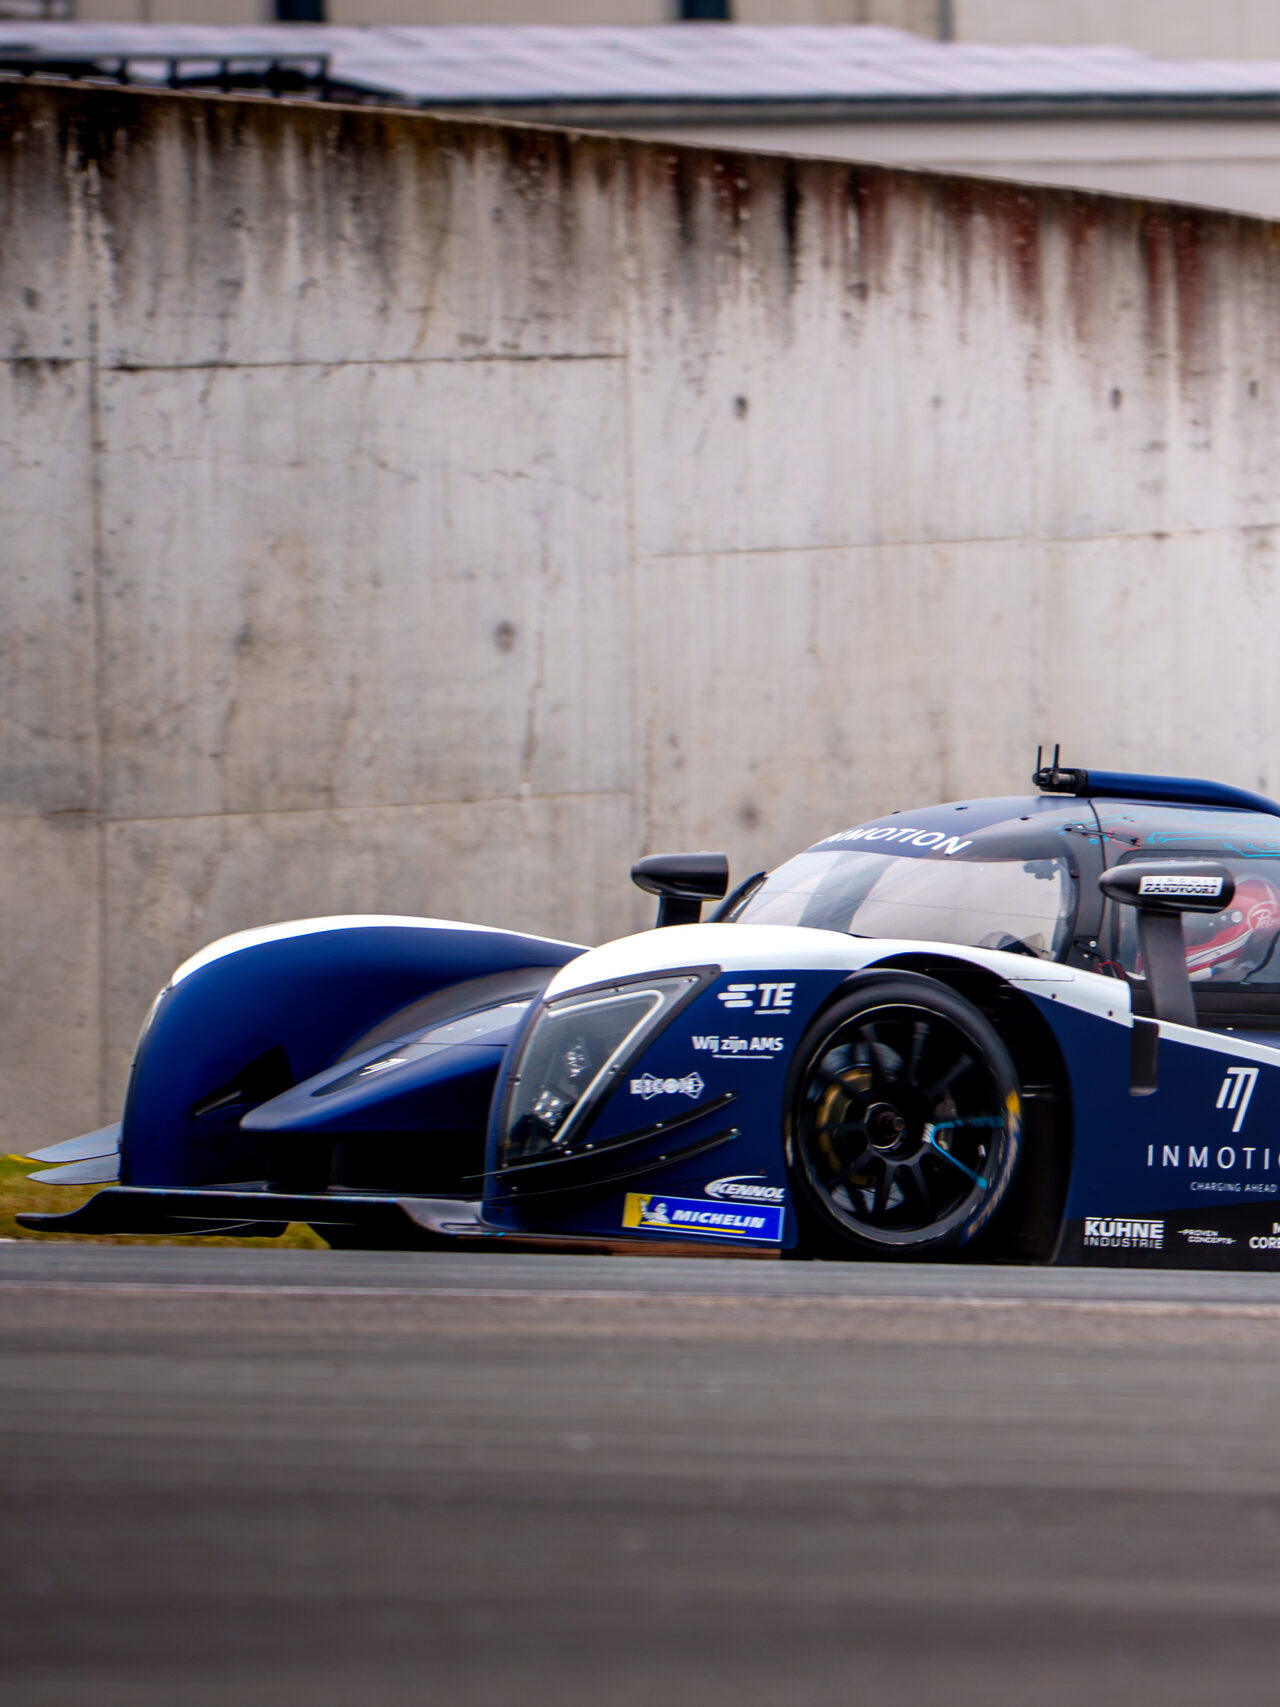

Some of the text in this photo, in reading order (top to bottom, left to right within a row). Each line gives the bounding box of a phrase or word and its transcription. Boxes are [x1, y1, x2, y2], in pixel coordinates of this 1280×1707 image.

[757, 982, 796, 1007] TE
[691, 1036, 784, 1053] Wij zijn AMS
[713, 1182, 785, 1199] KENNOL
[1190, 1181, 1278, 1193] CHARGING AHEAD
[672, 1209, 766, 1229] MICHELIN
[1083, 1236, 1164, 1249] INDUSTRIE
